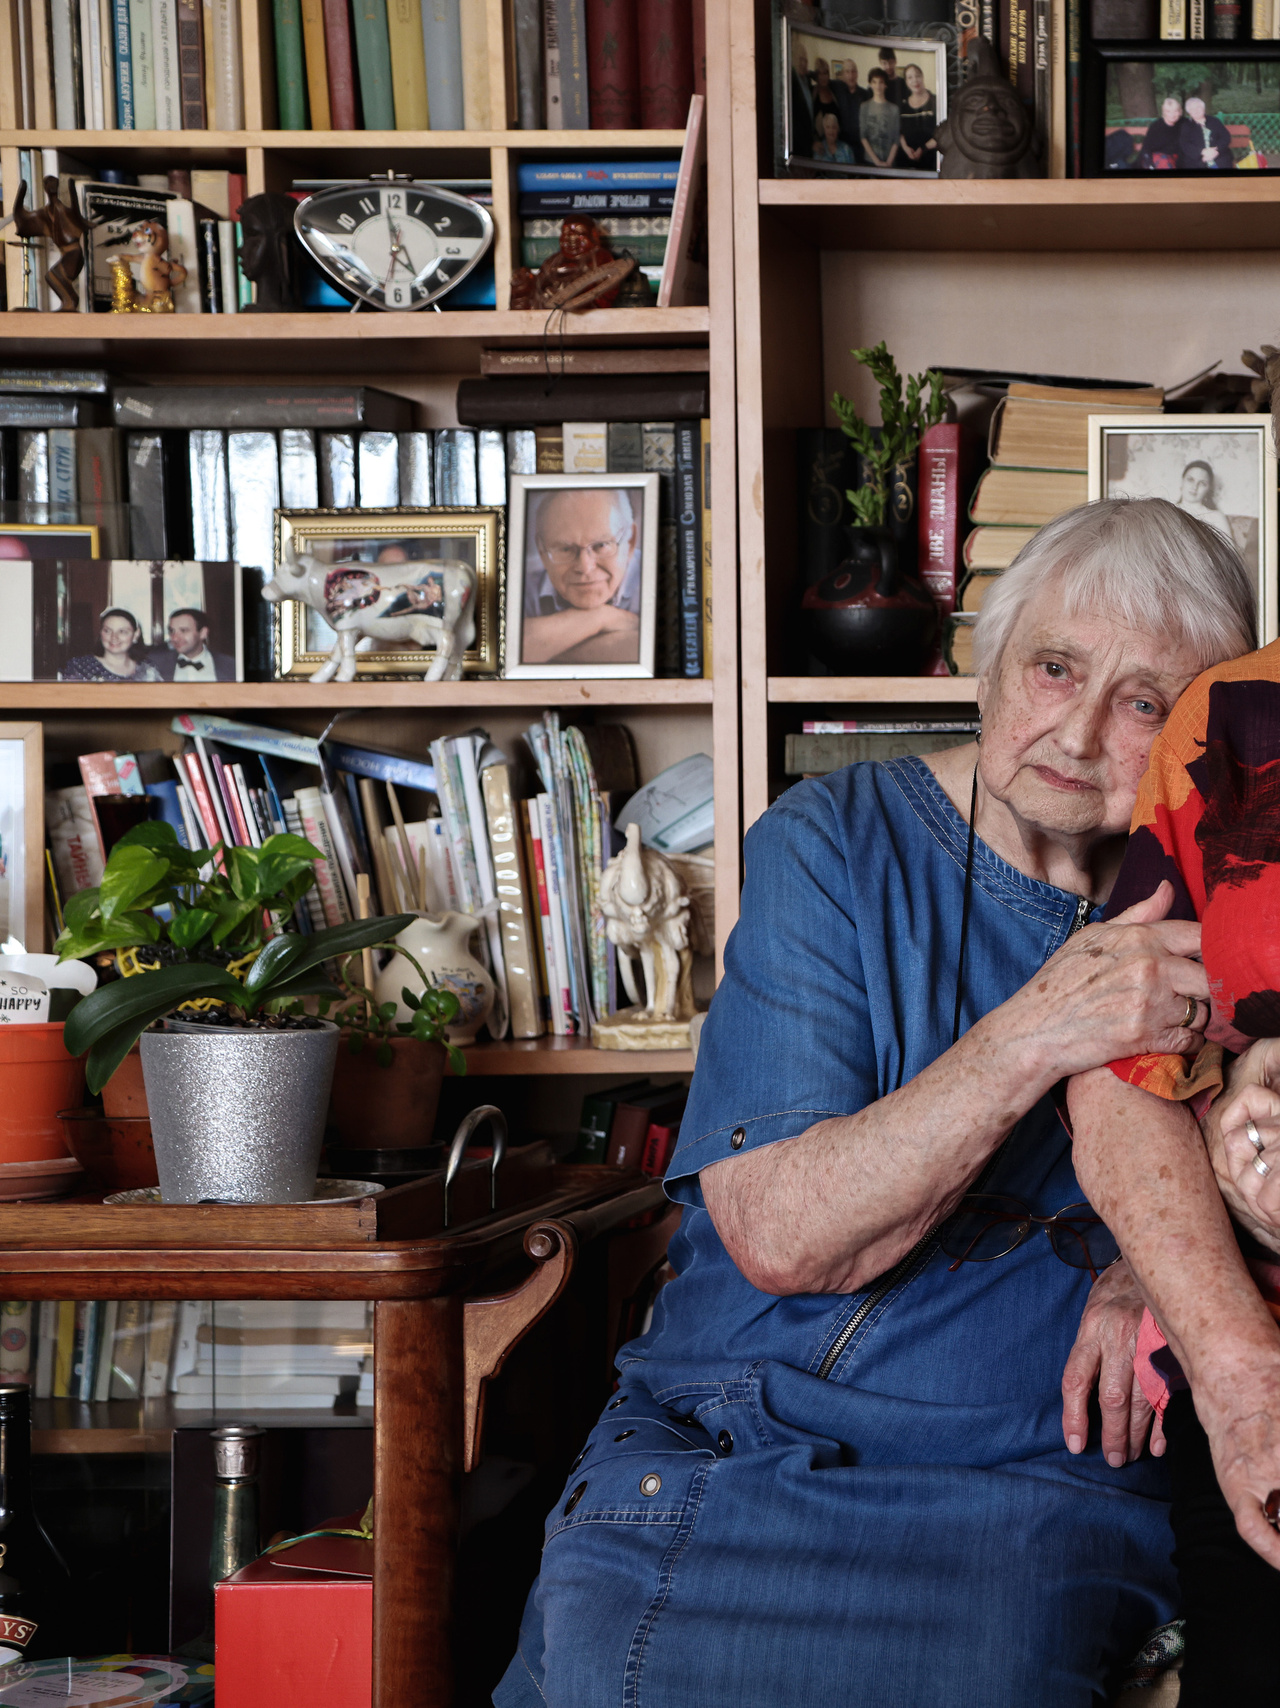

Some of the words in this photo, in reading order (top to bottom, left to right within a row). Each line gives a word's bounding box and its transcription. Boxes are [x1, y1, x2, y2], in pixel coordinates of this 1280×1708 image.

[1017, 8, 1027, 39] МУРРА
[1035, 15, 1048, 41] Грин
[1017, 41, 1027, 65] КОТА
[1035, 42, 1048, 71] Грэм
[119, 61, 132, 102] АКУНИН
[359, 197, 376, 215] 11
[387, 193, 401, 209] 12
[414, 200, 425, 215] 1
[336, 213, 356, 231] 10
[434, 216, 452, 233] 2
[446, 247, 461, 256] 3
[435, 268, 451, 283] 4
[393, 288, 403, 303] 6
[500, 354, 539, 364] АЗИМОВ
[928, 457, 947, 522] ДИАНЫ
[897, 494, 908, 510] 2
[928, 528, 946, 564] ДВЕ
[11, 986, 28, 996] SO
[0, 997, 42, 1011] HAPPY
